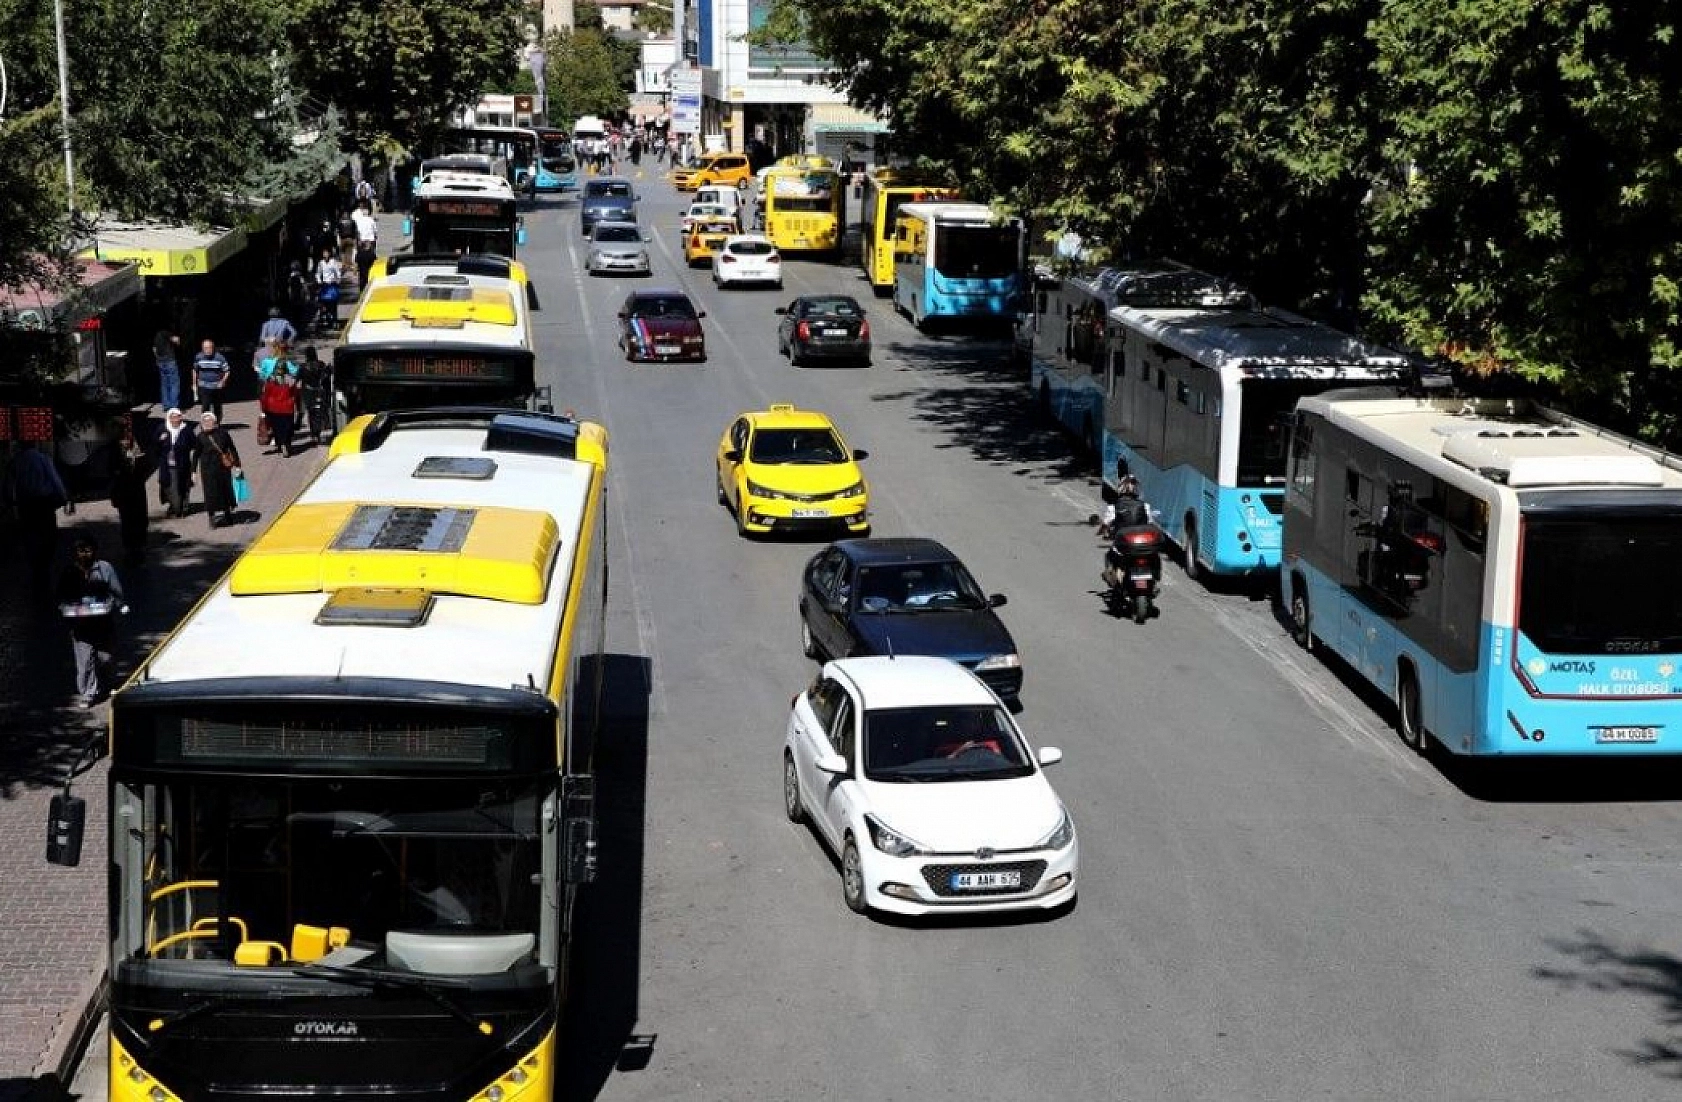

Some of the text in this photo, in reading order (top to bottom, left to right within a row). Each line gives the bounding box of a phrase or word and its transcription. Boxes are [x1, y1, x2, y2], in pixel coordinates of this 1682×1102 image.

[1550, 661, 1596, 675] MOTAŞ
[1611, 667, 1638, 680] ÖZEL
[1579, 683, 1610, 695] HALK
[1613, 681, 1669, 695] OTOBÜSÜ
[959, 875, 971, 886] 44
[294, 1021, 358, 1035] OTOKAR
